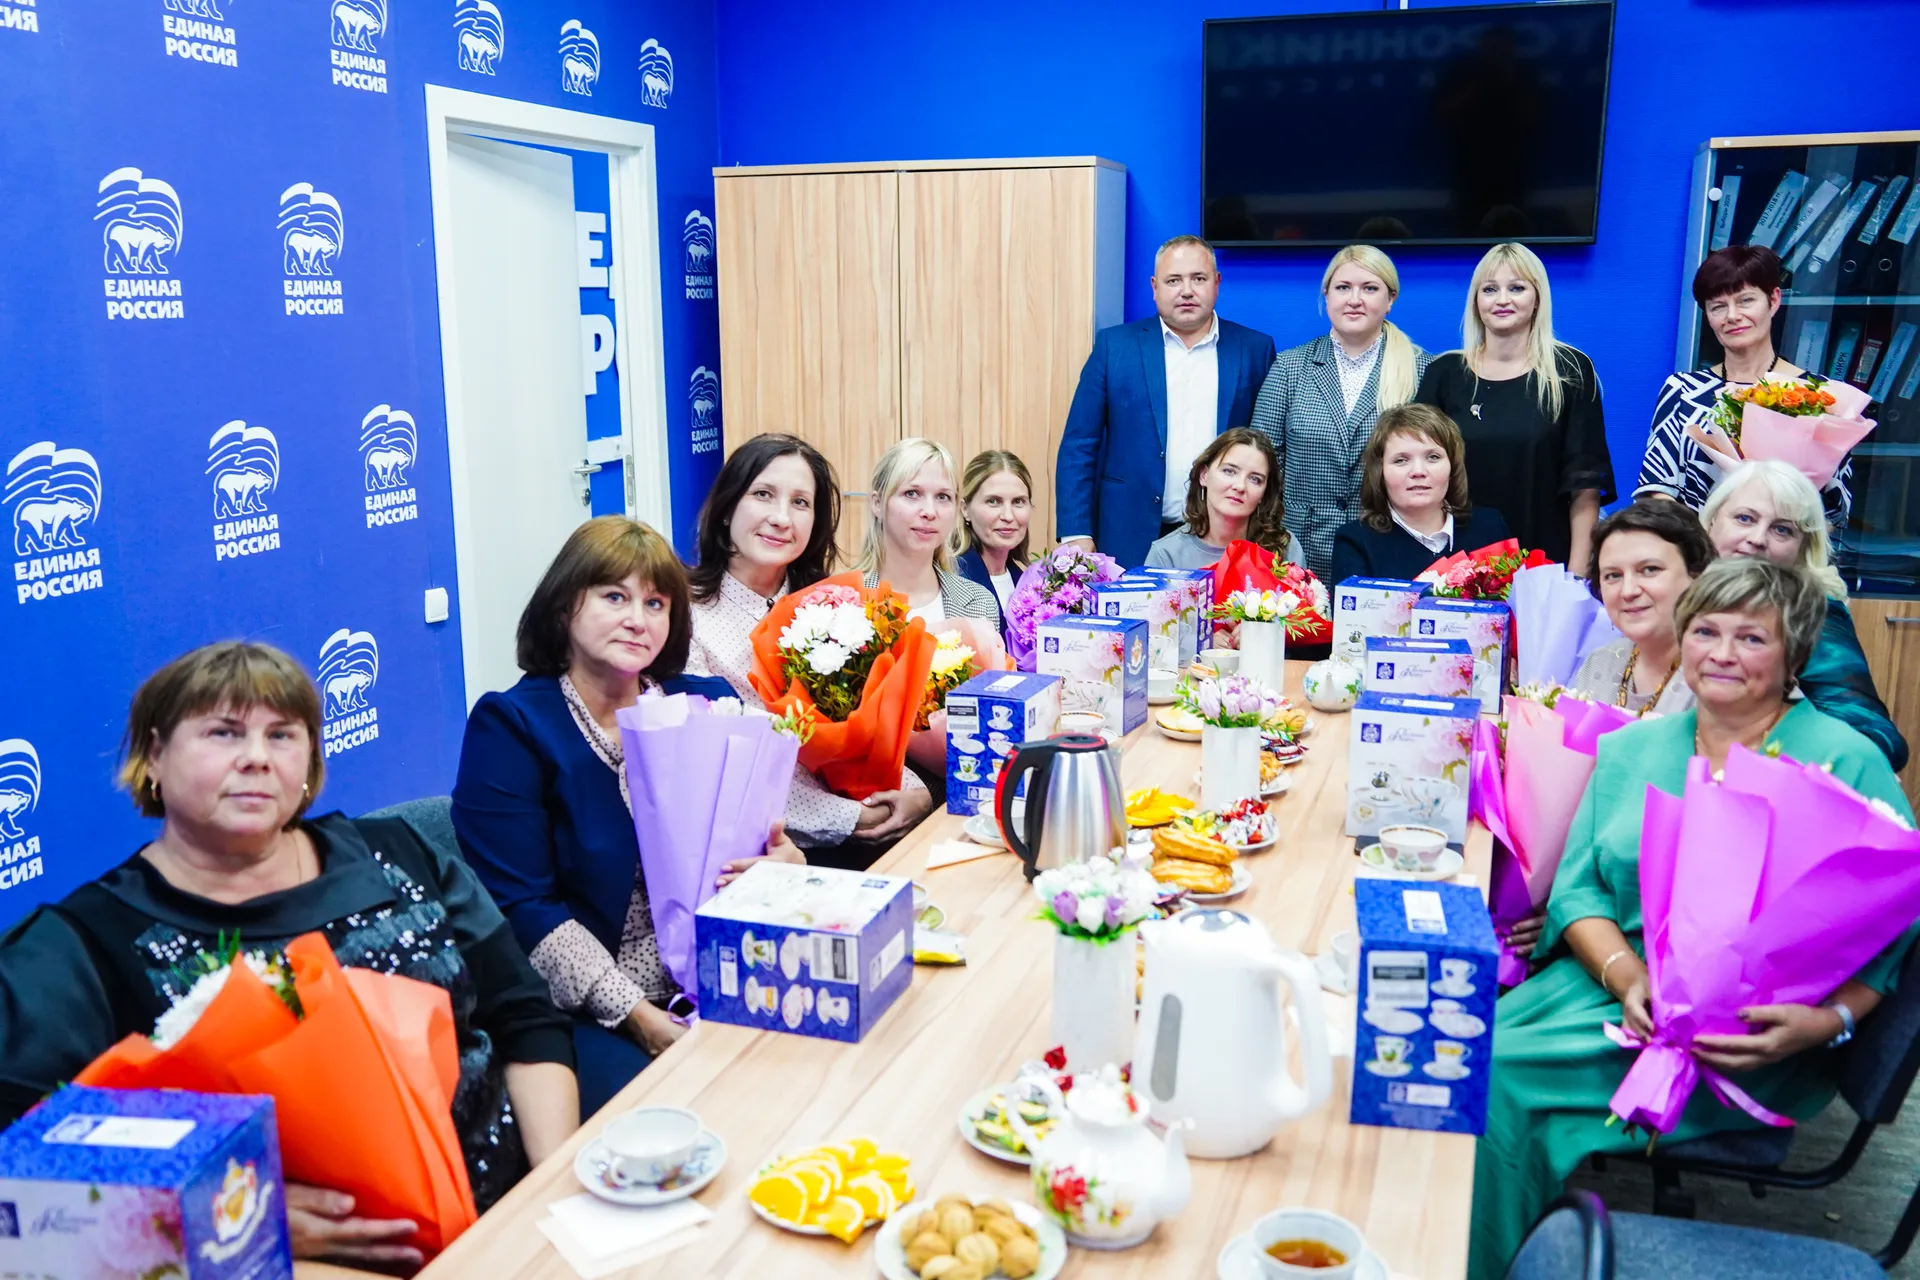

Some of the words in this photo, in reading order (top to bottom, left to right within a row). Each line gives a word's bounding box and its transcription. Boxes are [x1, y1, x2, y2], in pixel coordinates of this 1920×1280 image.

[163, 15, 235, 45] ЕДИНАЯ
[165, 37, 238, 67] РОССИЯ
[331, 49, 386, 74] ЕДИНАЯ
[332, 68, 388, 94] РОССИЯ
[1758, 196, 1778, 226] 2017-2018
[104, 279, 181, 299] ЕДИНАЯ
[283, 280, 342, 296] ЕДИНАЯ
[685, 275, 713, 286] ЕДИНАЯ
[686, 288, 713, 299] РОССИЯ
[106, 299, 184, 320] РОССИЯ
[285, 297, 344, 316] РОССИЯ
[1834, 350, 1847, 377] МКРК
[692, 428, 718, 441] ЕДИНАЯ
[692, 440, 718, 454] РОССИЯ
[365, 488, 416, 512] ЕДИНАЯ
[213, 514, 279, 541] ЕДИНАЯ
[366, 505, 418, 528] РОССИЯ
[215, 532, 281, 561] РОССИЯ
[14, 548, 101, 581] ЕДИНАЯ
[17, 569, 103, 604] РОССИЯ
[323, 708, 378, 740] ЕДИНАЯ
[325, 724, 379, 758] РОССИЯ
